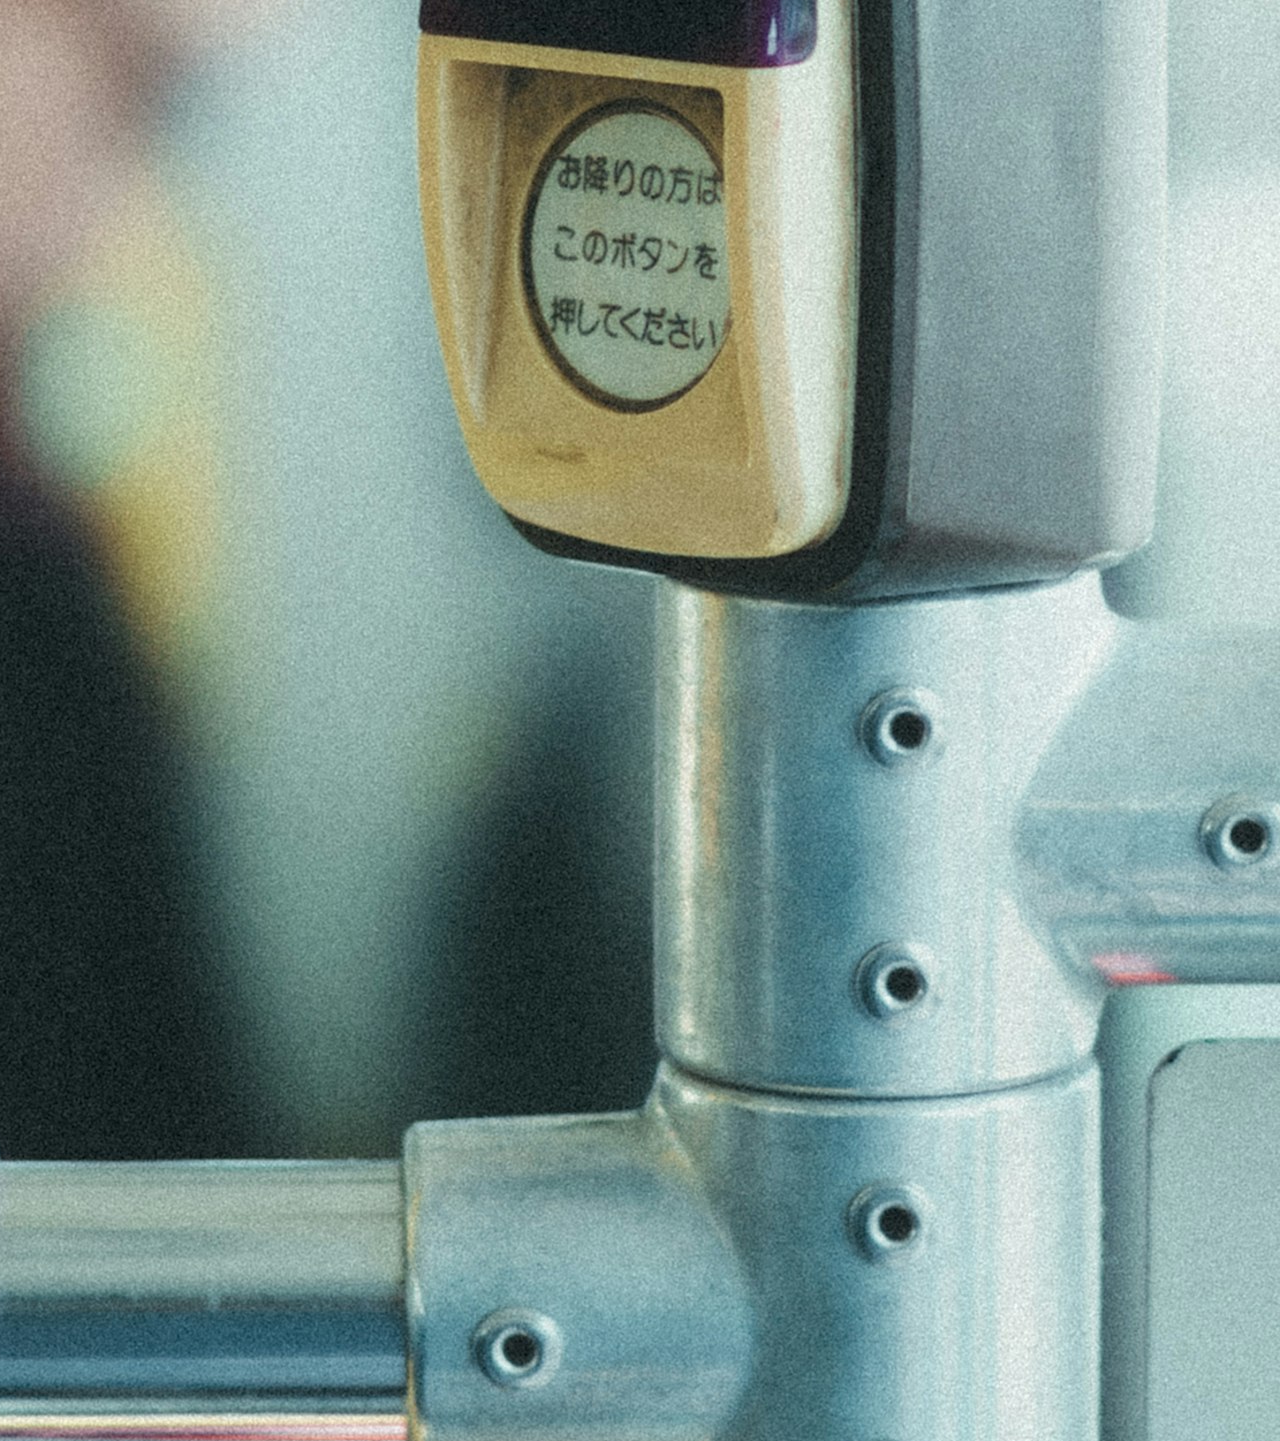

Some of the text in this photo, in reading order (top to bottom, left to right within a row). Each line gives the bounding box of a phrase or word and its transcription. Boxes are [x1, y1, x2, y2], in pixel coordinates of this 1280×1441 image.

[557, 155, 721, 205] お降りの方は
[554, 225, 719, 280] このボタンを
[551, 296, 717, 350] 押してください
